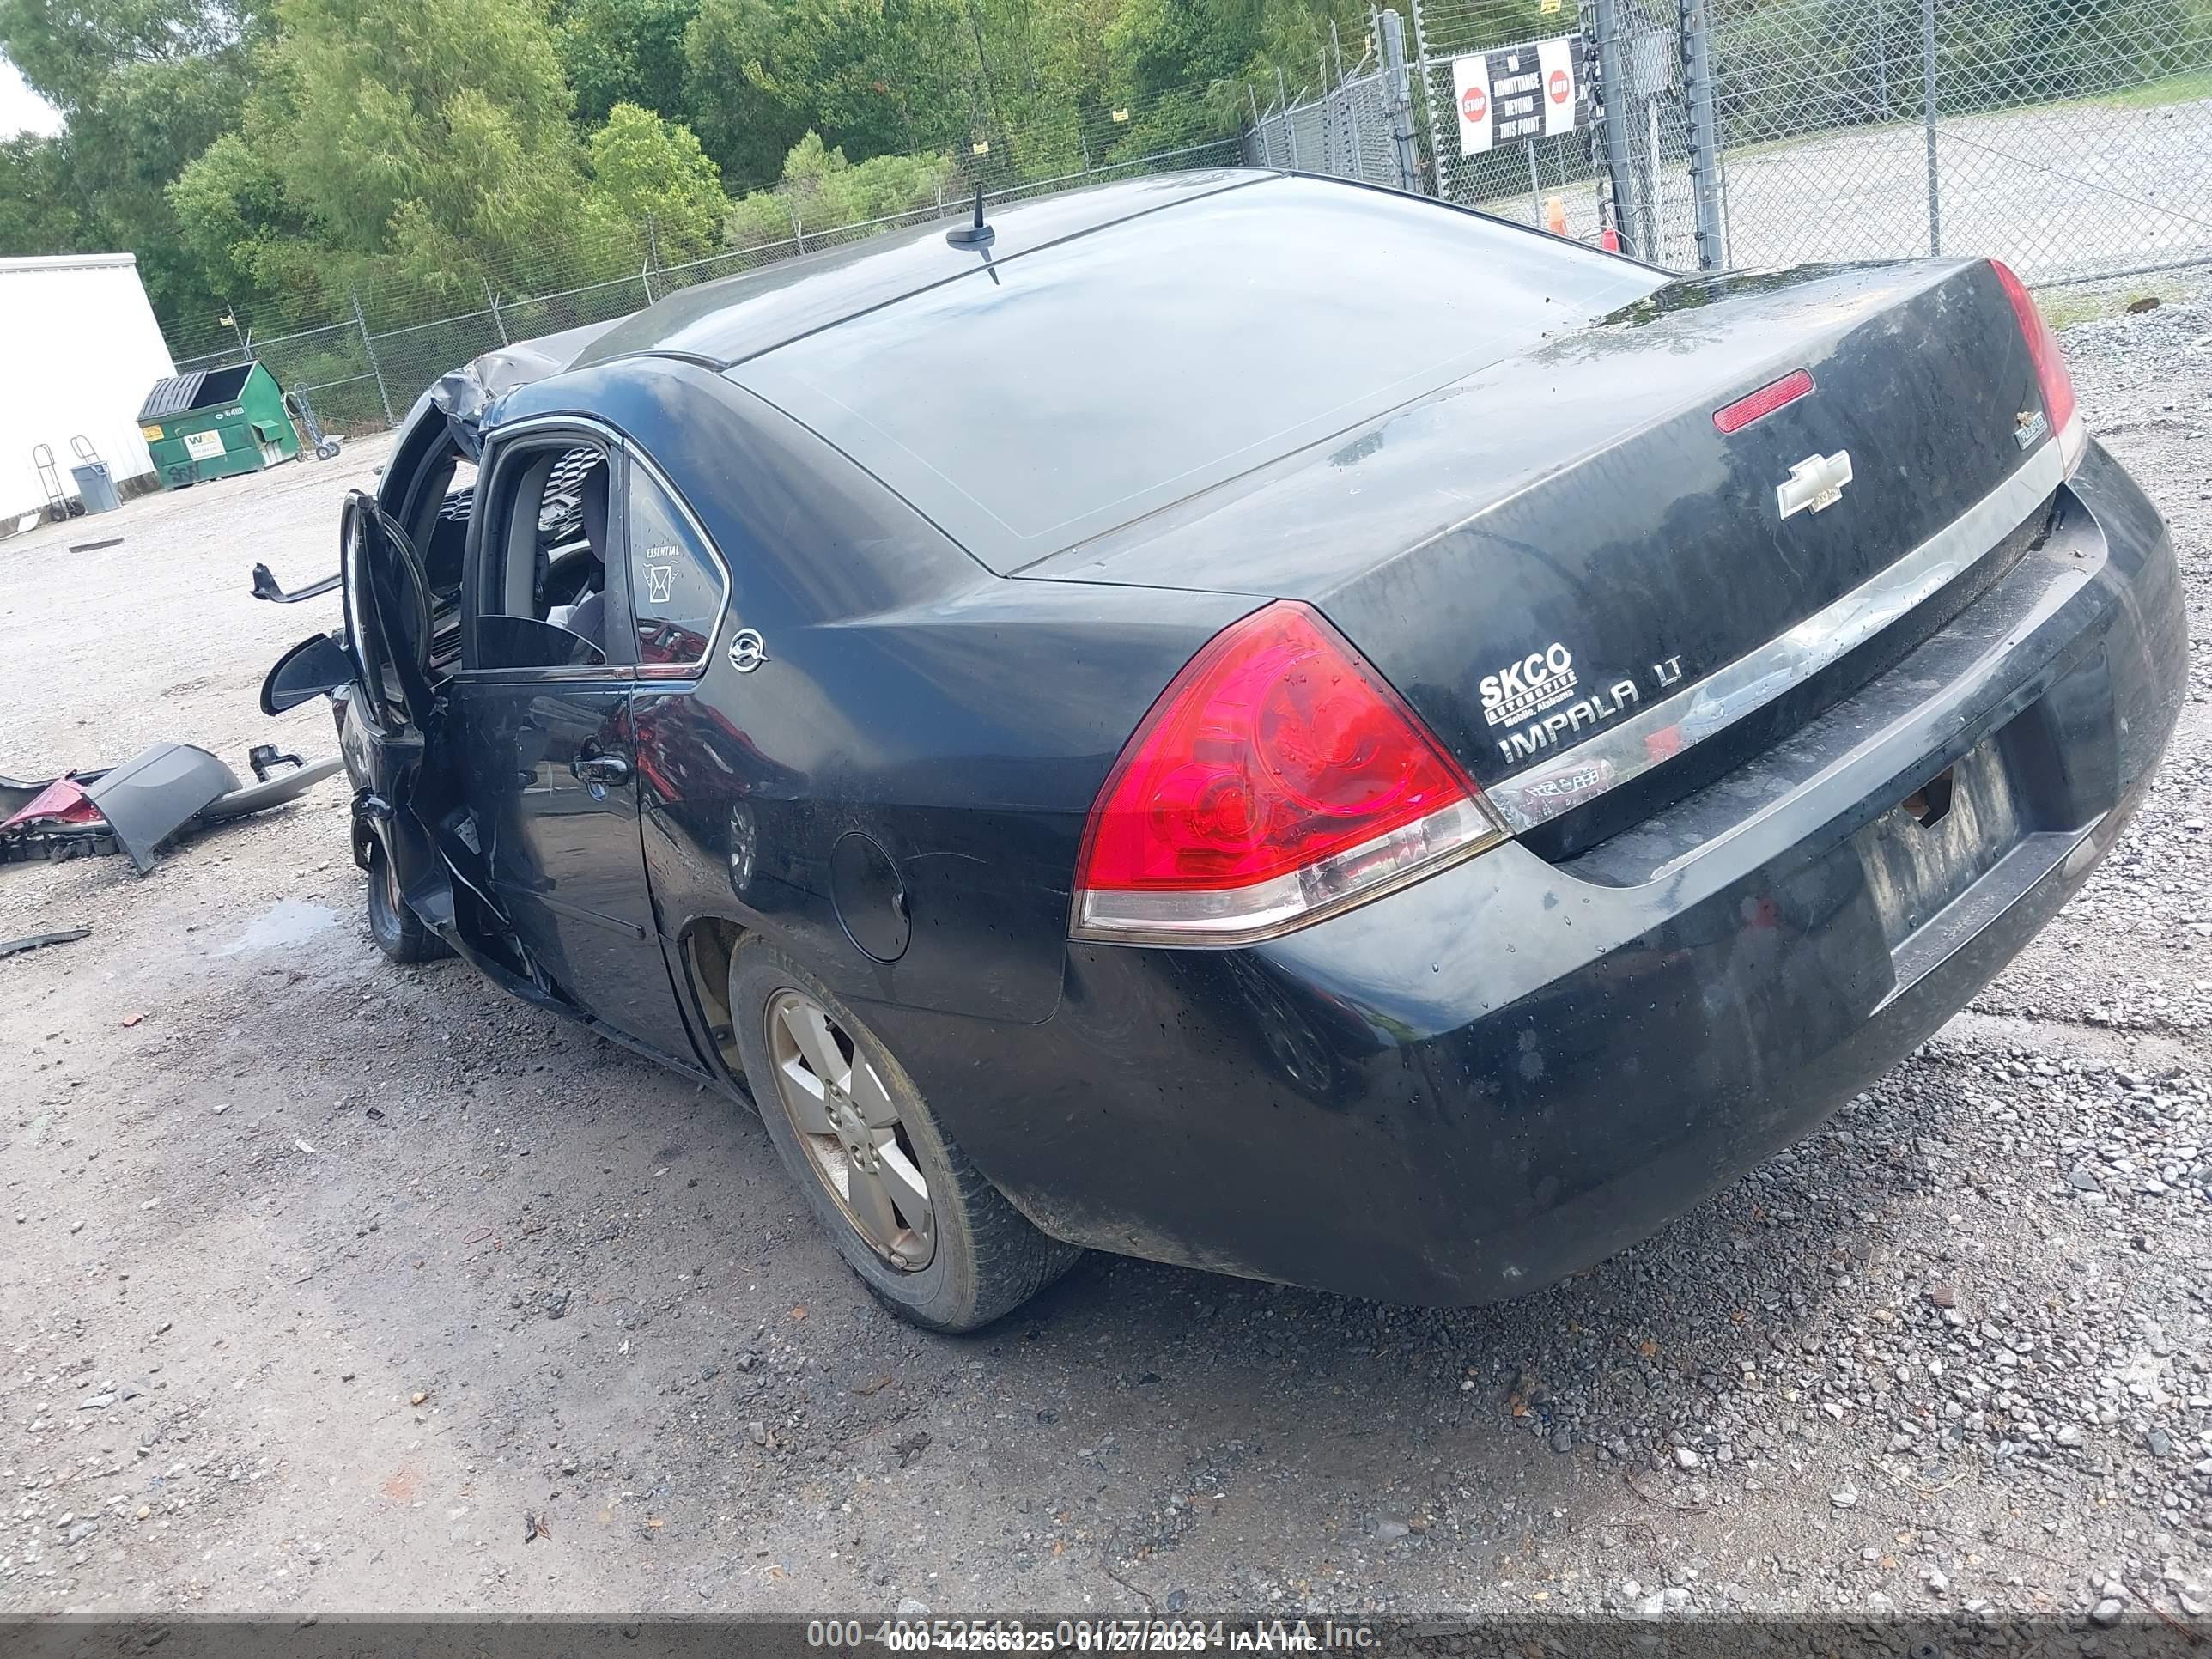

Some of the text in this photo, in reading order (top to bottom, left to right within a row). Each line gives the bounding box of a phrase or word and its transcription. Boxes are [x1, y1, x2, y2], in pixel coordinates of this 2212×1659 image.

[1507, 54, 1519, 72] NO
[1494, 72, 1540, 97] ADMITTANCE
[1463, 97, 1485, 112] STOP
[1504, 96, 1534, 117] BEYOND
[1499, 115, 1540, 139] THIS POINT
[647, 545, 679, 558] ESSENTIAL
[1479, 641, 1571, 708] SKCO
[1487, 670, 1577, 721] AUTOMOTIVE
[1498, 654, 1682, 764] IMPALA LT
[1504, 688, 1575, 728] Mobile, Alabama
